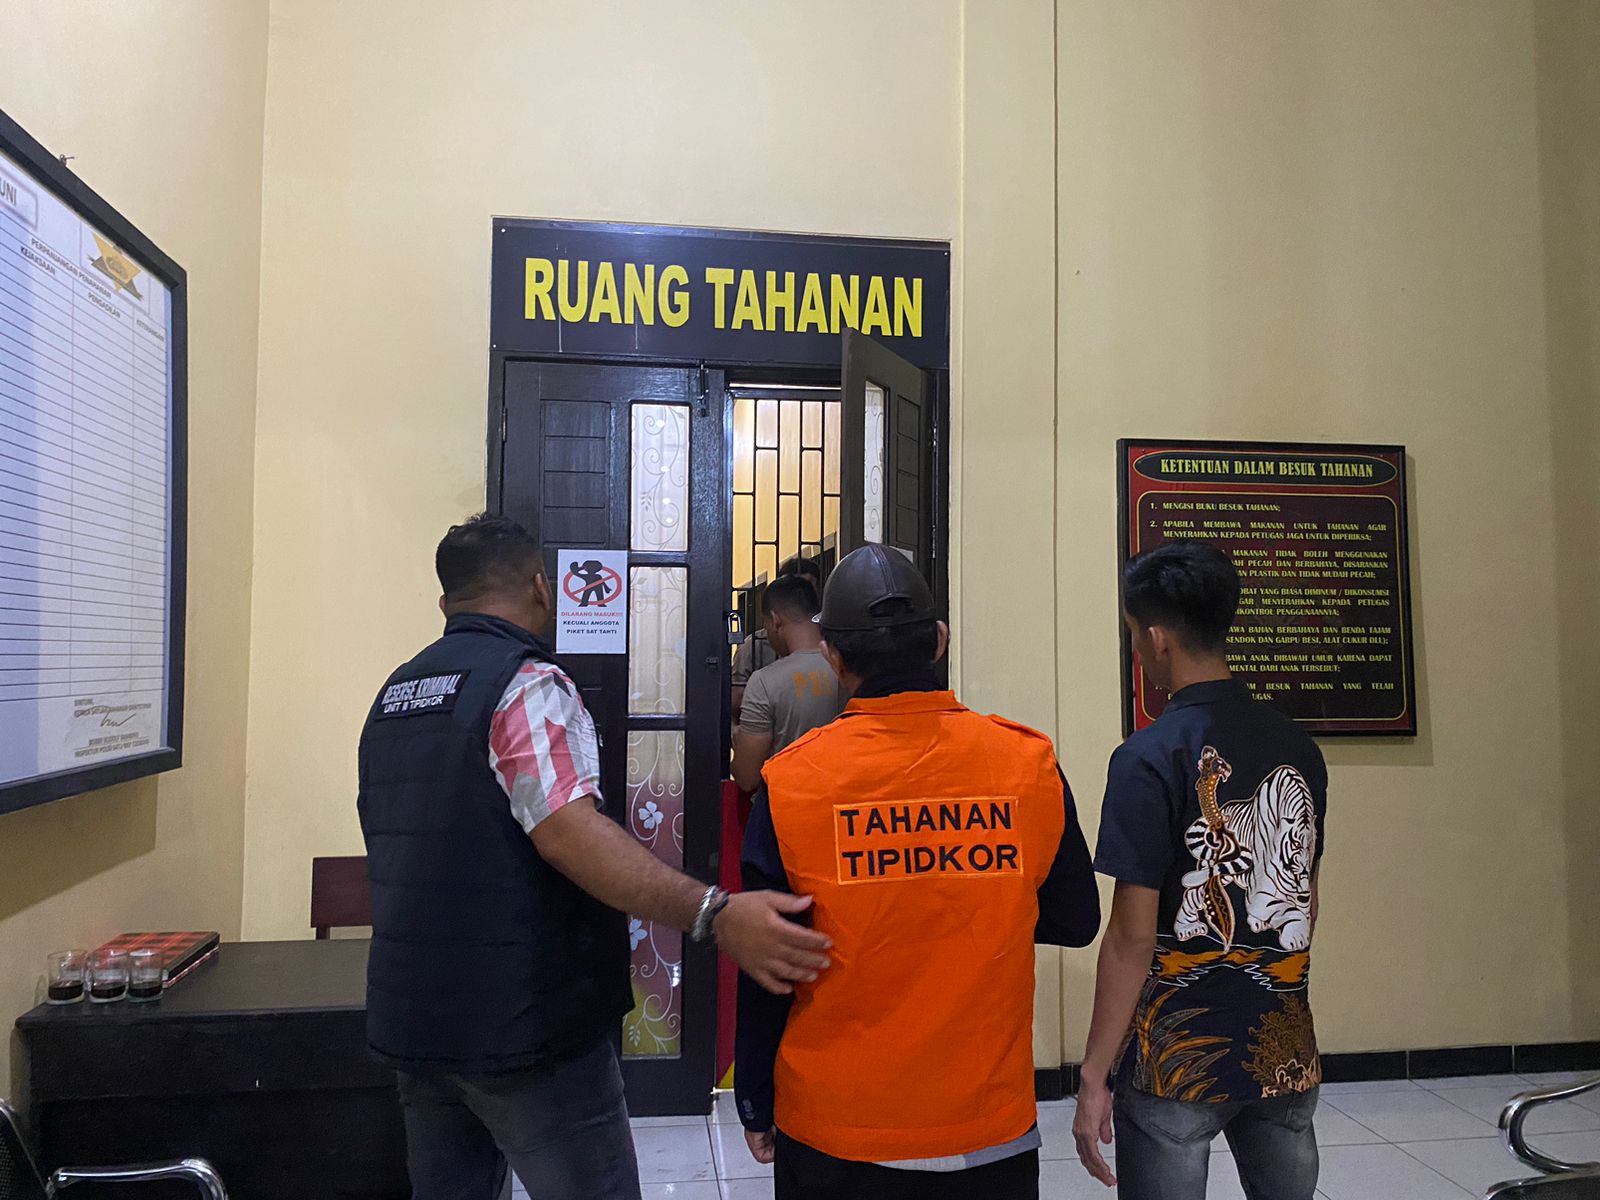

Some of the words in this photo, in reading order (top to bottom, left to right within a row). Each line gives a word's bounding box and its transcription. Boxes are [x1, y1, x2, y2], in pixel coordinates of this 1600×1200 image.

[21, 246, 56, 276] KEJAKSAAN
[524, 257, 690, 328] RUANG
[705, 267, 922, 338] TAHANAN
[1160, 459, 1230, 474] KETENTUAN
[1234, 460, 1274, 475] DALAM
[1279, 462, 1316, 476] BESUK
[1320, 464, 1373, 478] TAHANAN
[1150, 502, 1158, 510] 1.
[1162, 502, 1194, 510] MENGISI
[1150, 520, 1158, 528] 2.
[1162, 520, 1194, 528] APABILA
[1294, 522, 1318, 530] UNTUK
[1163, 530, 1218, 538] MENYERAHKAN
[1286, 532, 1304, 540] JAGA
[1304, 550, 1328, 558] BOLEH
[1226, 636, 1256, 644] SENDOK
[416, 674, 461, 698] KRIMINAL
[384, 702, 402, 713] UNIT
[840, 802, 1011, 836] TAHANAN
[842, 844, 1018, 877] TIPIDKOR
